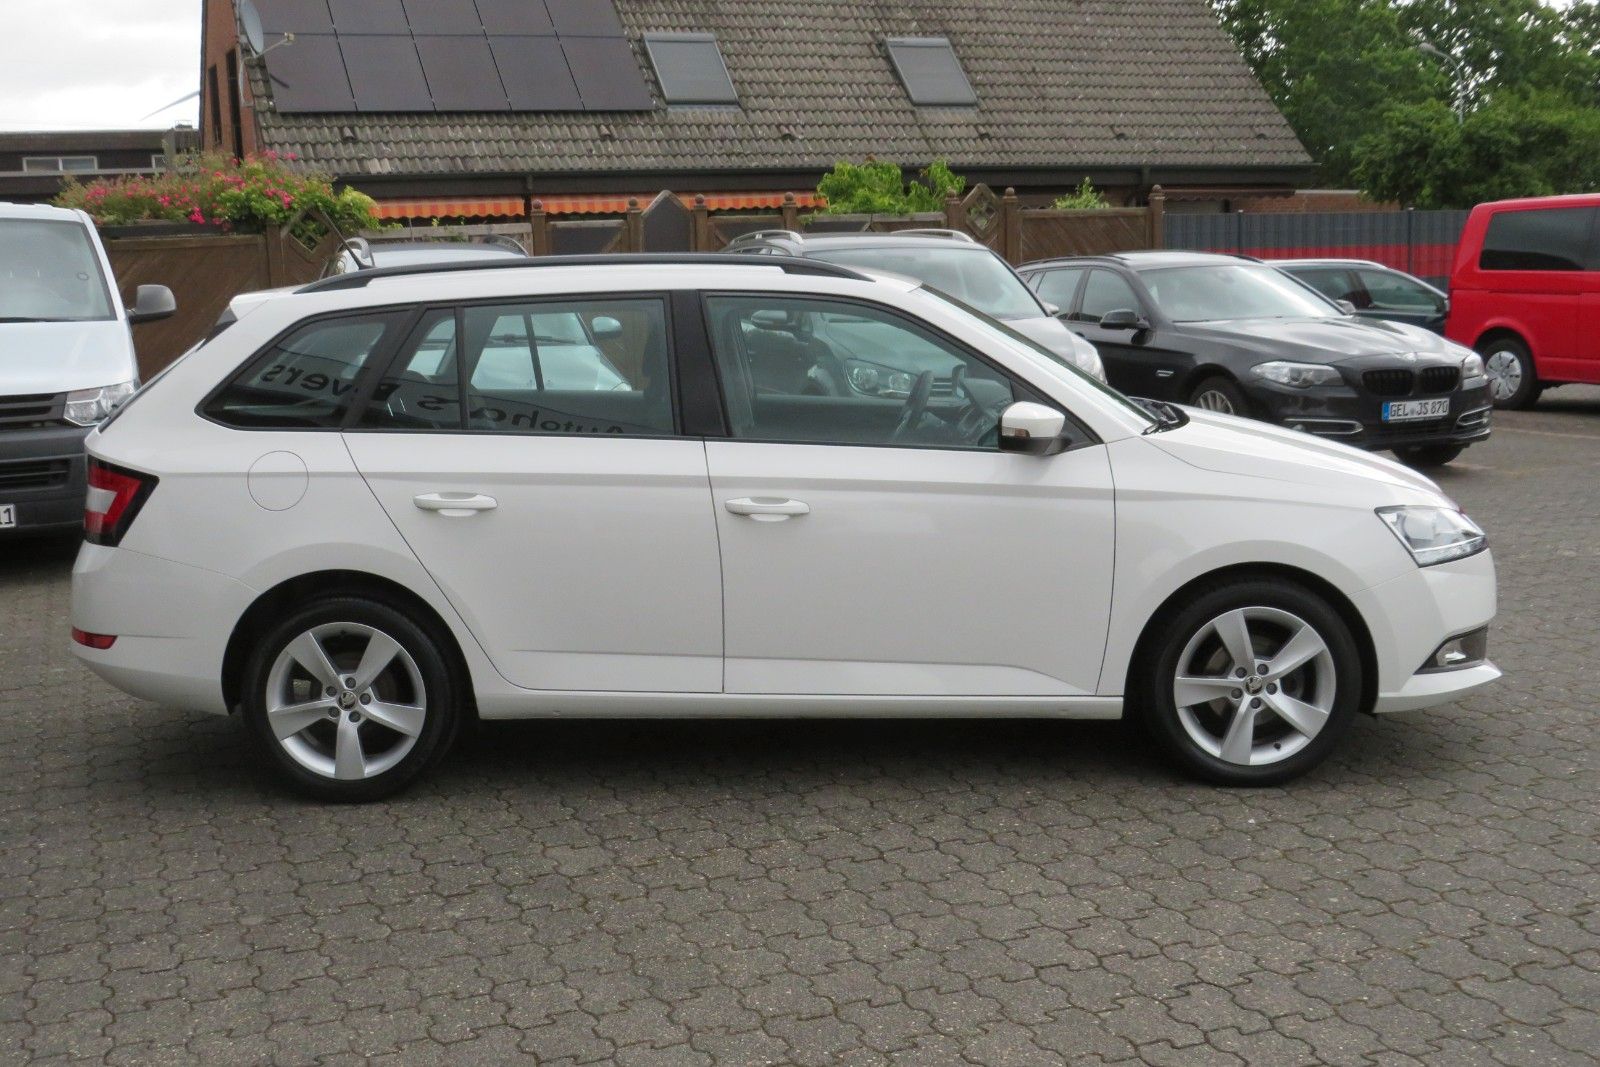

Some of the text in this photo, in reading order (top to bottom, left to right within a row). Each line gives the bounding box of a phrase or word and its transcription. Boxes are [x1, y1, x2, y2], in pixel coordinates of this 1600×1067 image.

[1390, 400, 1448, 417] GEL JS 870
[0, 507, 13, 525] 1
